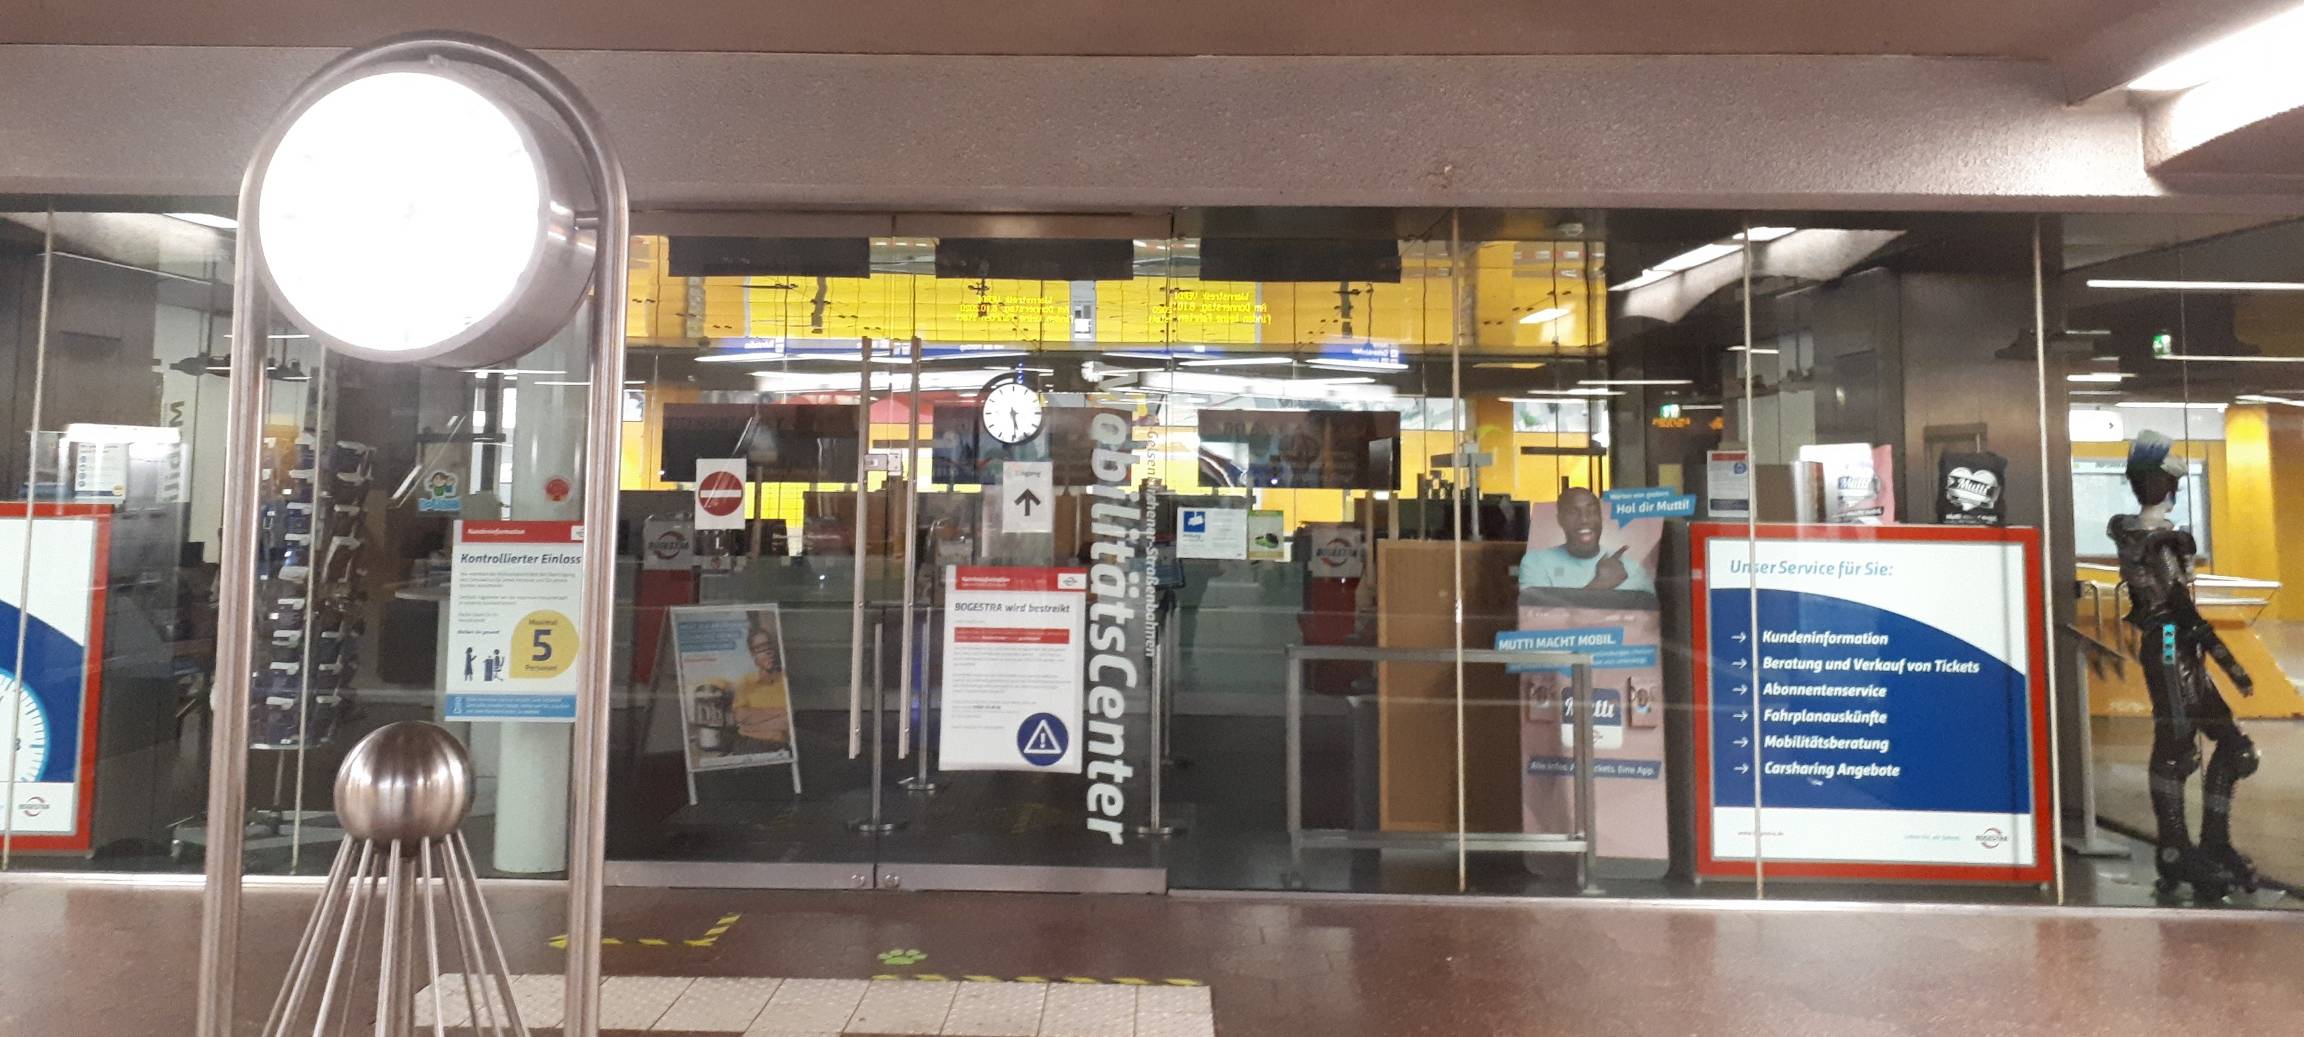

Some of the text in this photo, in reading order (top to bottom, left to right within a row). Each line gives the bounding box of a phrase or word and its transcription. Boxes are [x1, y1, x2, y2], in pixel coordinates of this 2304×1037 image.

[1638, 501, 1655, 513] dir
[460, 553, 582, 565] Kontrollierter Einlass
[1778, 560, 1834, 575] Service
[1838, 560, 1862, 580] für
[1865, 561, 1893, 576] Sie:
[954, 602, 1070, 614] BOGESTRA wird bestreikt
[532, 629, 552, 661] 5
[1499, 639, 1533, 650] MUTTI
[1536, 636, 1576, 649] MACHT
[1762, 630, 1888, 647] Kundeninformation
[1763, 656, 1980, 675] Beratung und Verkauf von Tickets
[1763, 683, 1887, 698] Abonnentenservice
[1763, 709, 1888, 726] Fahrplanauskünfte
[1764, 735, 1890, 753] Mobilitätsberatung
[1765, 761, 1901, 779] Carsharing Angebote
